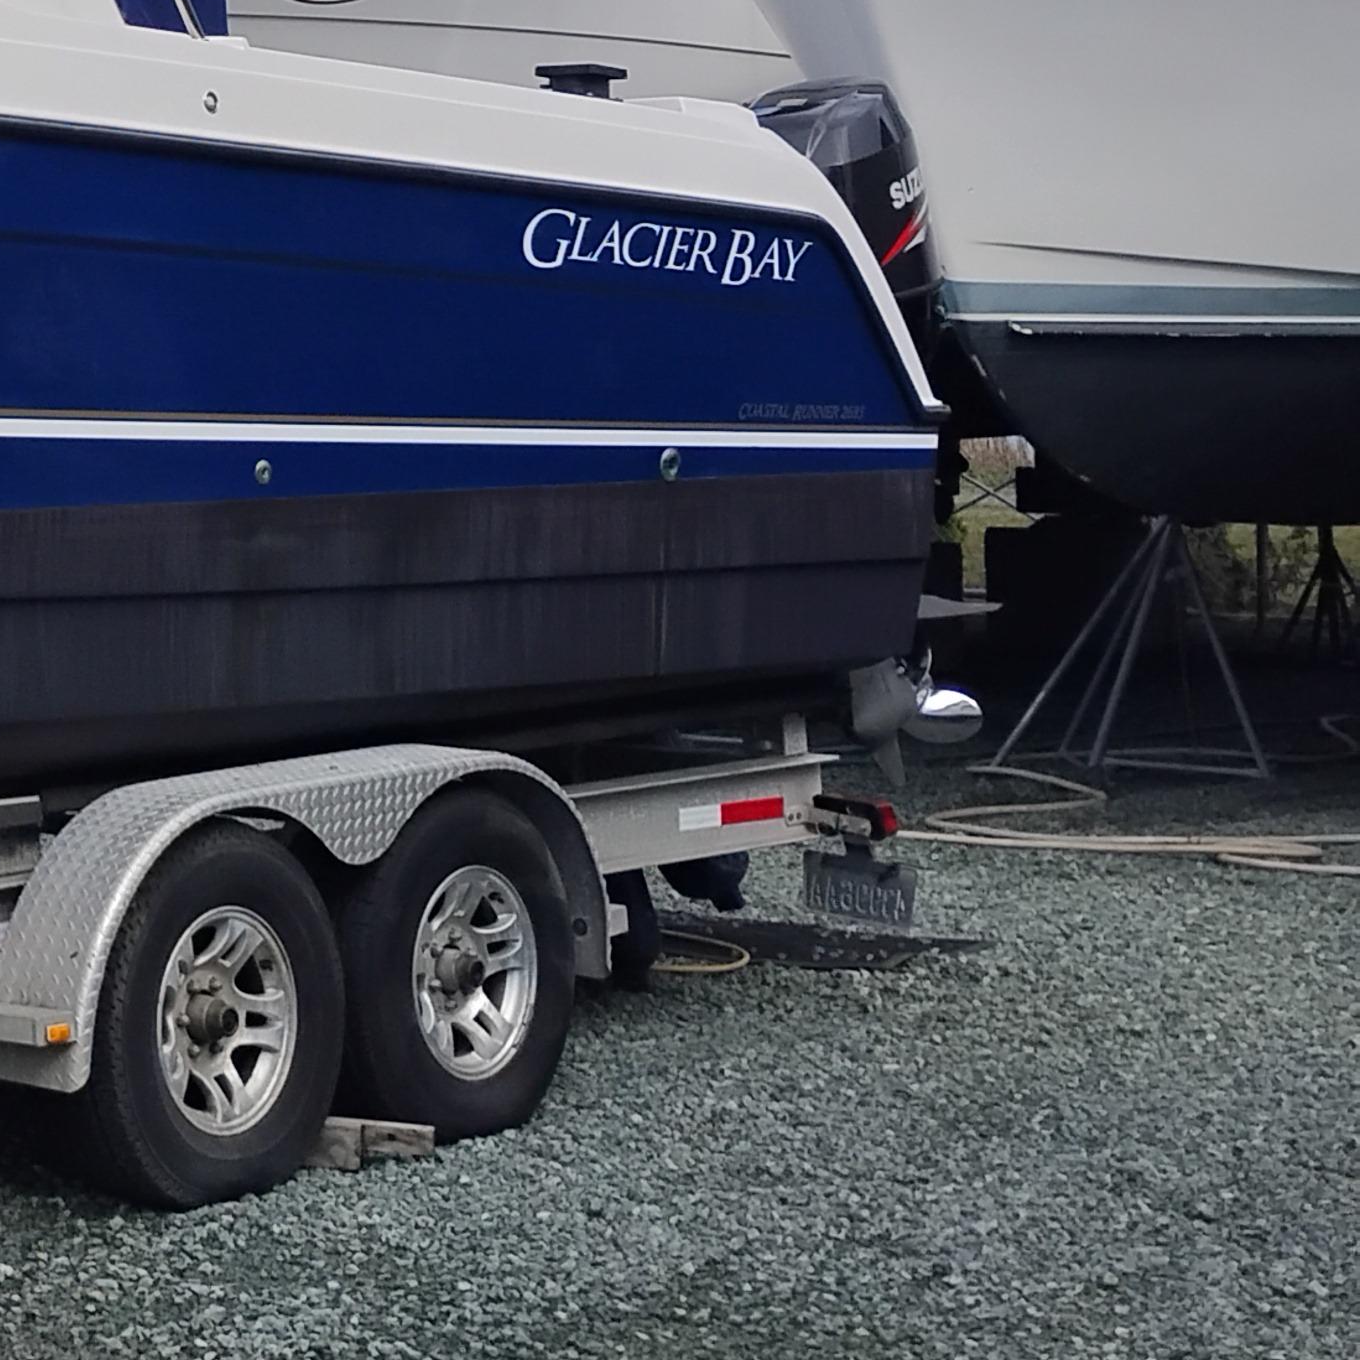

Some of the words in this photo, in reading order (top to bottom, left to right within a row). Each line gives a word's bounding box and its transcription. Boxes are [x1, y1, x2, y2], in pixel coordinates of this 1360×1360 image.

[889, 166, 921, 210] SUZ
[521, 207, 718, 275] GLACIER
[720, 228, 814, 287] BAY
[737, 402, 791, 421] COASTAL
[791, 403, 840, 421] RUNNER
